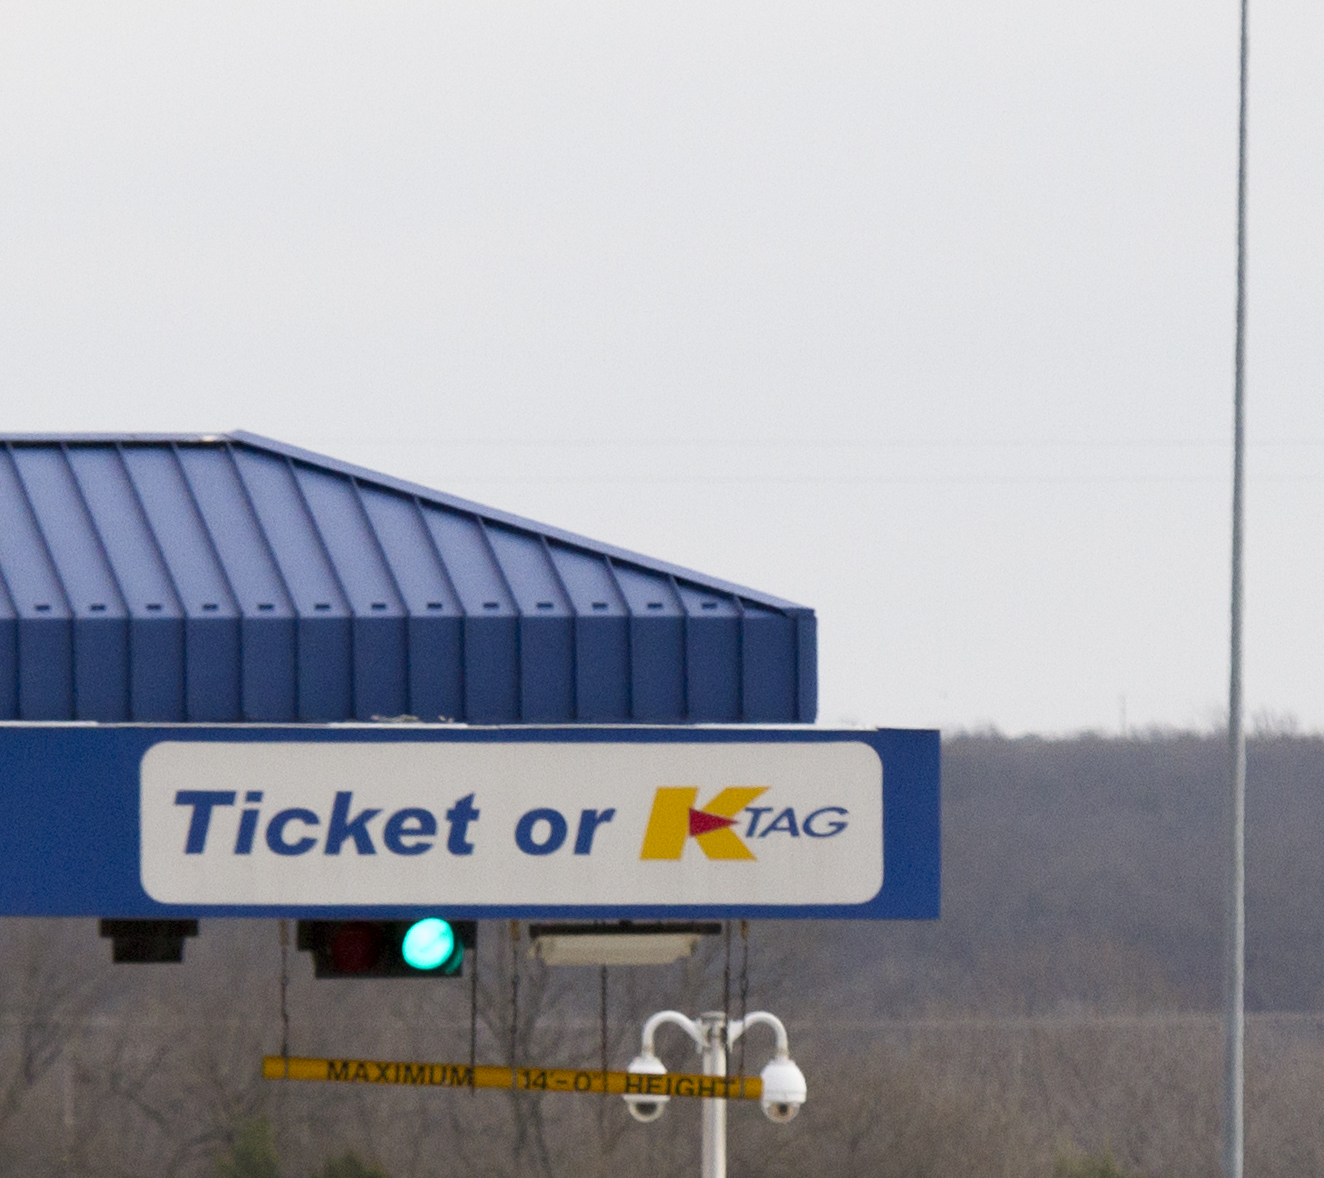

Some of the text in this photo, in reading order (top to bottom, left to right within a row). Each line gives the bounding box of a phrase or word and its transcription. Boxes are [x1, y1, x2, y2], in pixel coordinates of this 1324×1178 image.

[173, 789, 479, 857] Ticket
[514, 807, 616, 857] or
[326, 1060, 474, 1087] MAXIMUM
[624, 1072, 738, 1099] HEIGHT
